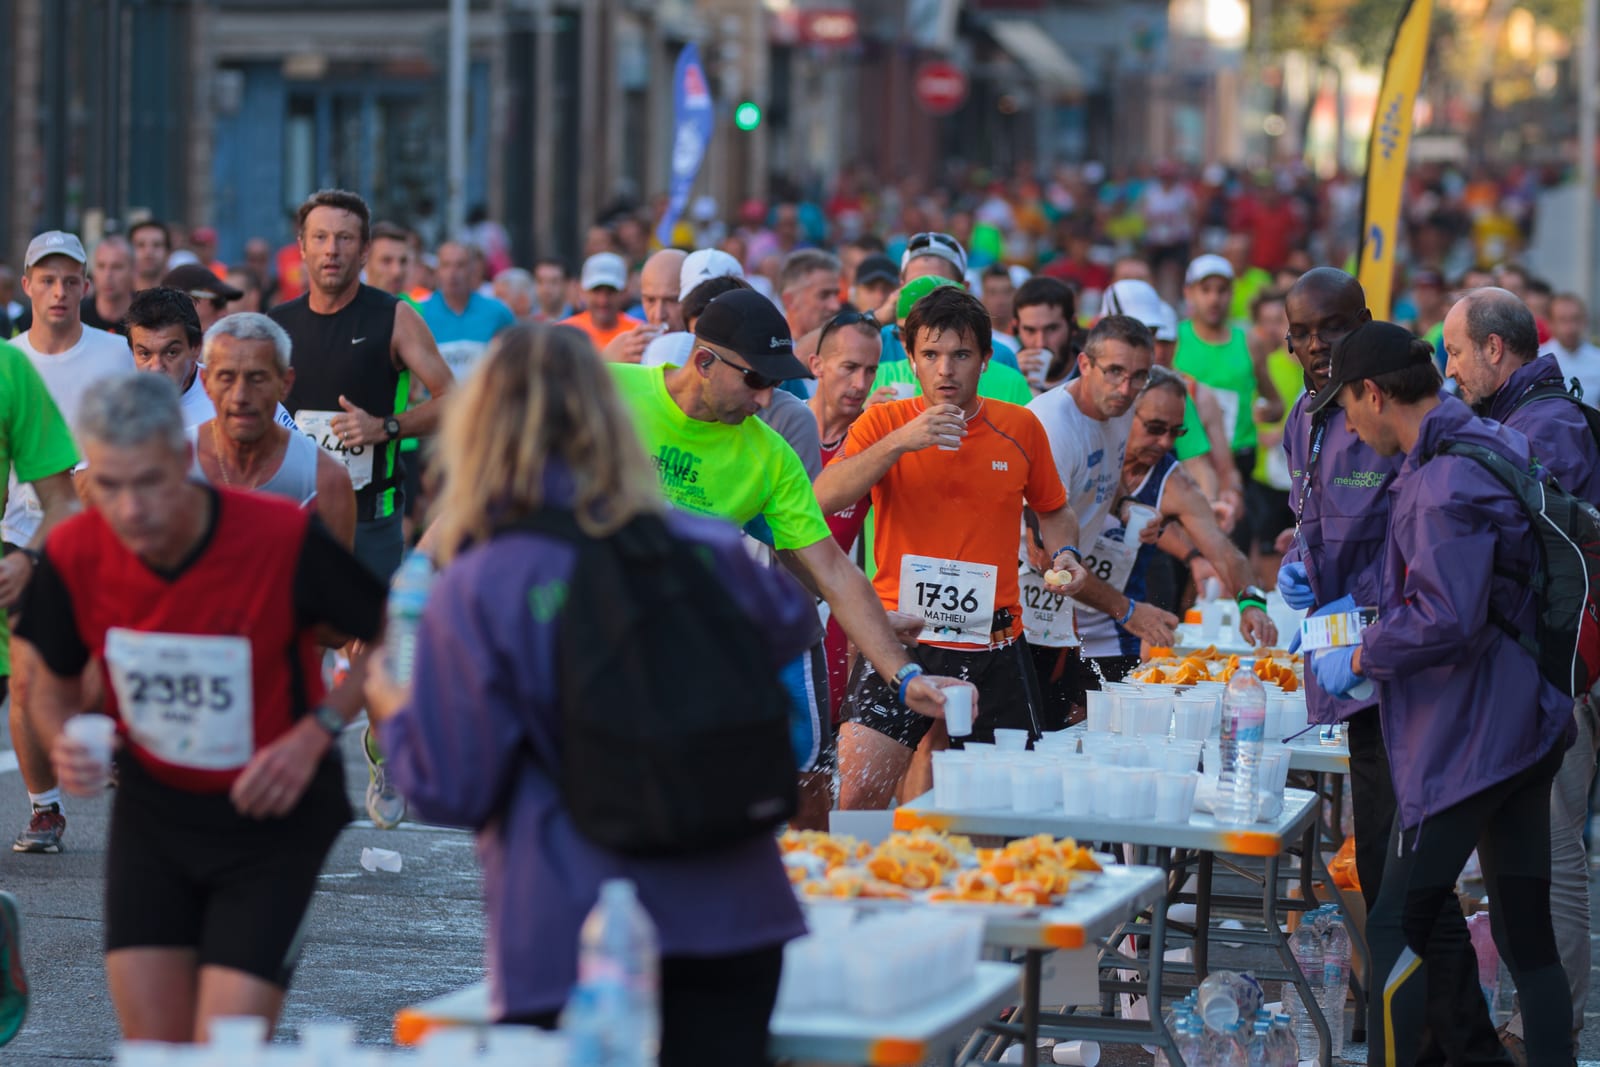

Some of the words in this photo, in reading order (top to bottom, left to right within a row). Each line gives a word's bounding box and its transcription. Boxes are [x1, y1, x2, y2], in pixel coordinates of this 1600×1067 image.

[915, 581, 978, 613] 1736
[1023, 584, 1065, 612] 1229
[924, 609, 967, 624] MATHIEU
